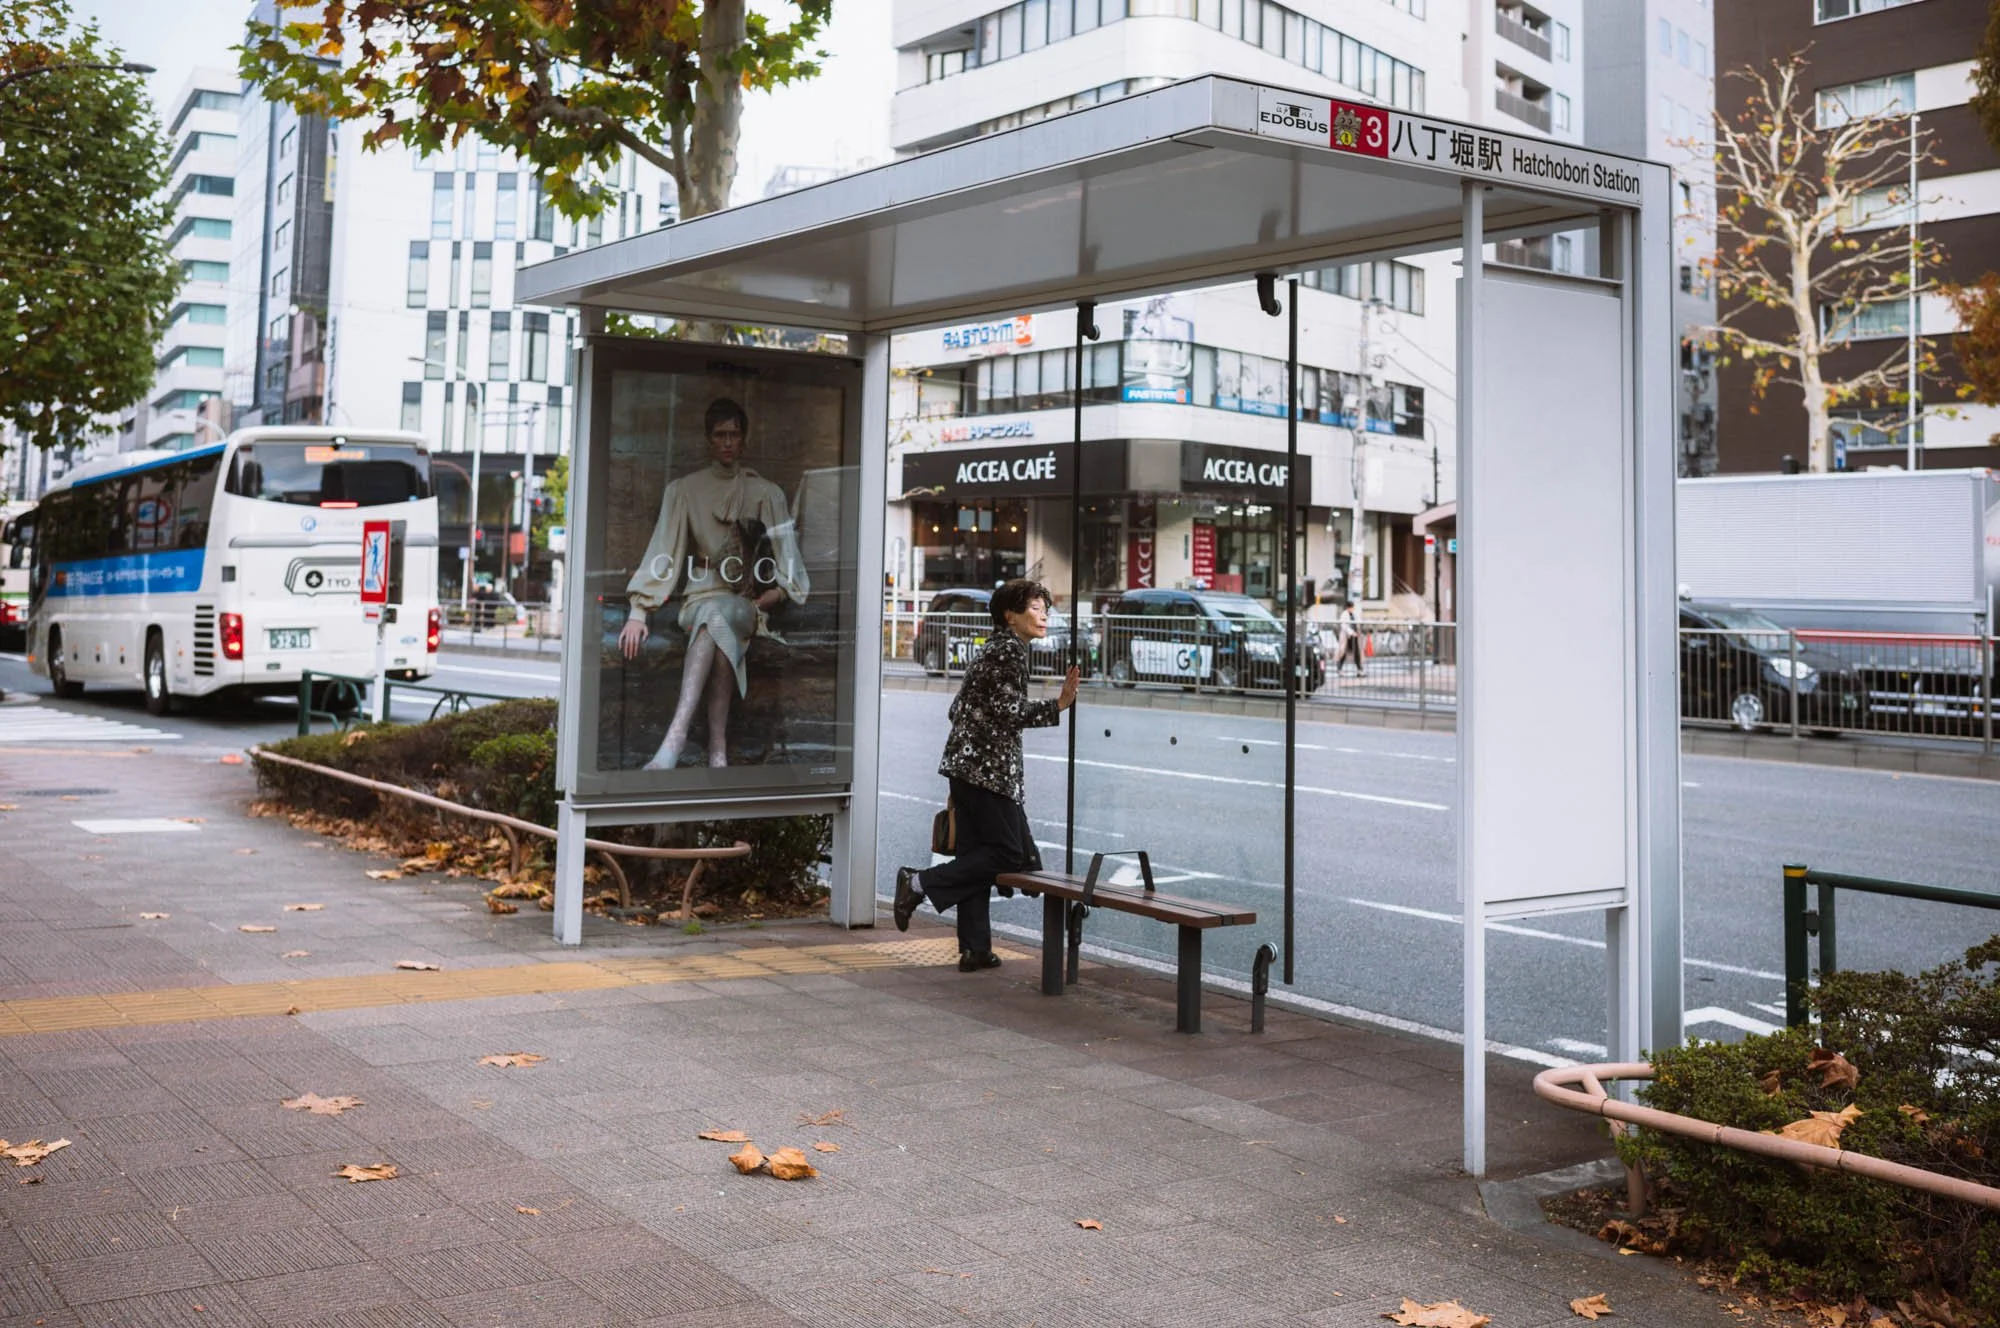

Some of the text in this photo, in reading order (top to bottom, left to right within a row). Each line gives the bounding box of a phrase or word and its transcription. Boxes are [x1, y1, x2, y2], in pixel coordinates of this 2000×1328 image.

[1260, 111, 1328, 134] EDOBUS
[1366, 116, 1383, 148] 3
[1392, 119, 1503, 173] 八丁堀駅
[1513, 147, 1640, 195] Hatchobori Station
[956, 450, 1057, 484] ACCEA CAFÉ
[1203, 457, 1289, 488] ACCEA CAF
[650, 553, 795, 585] GUCCI
